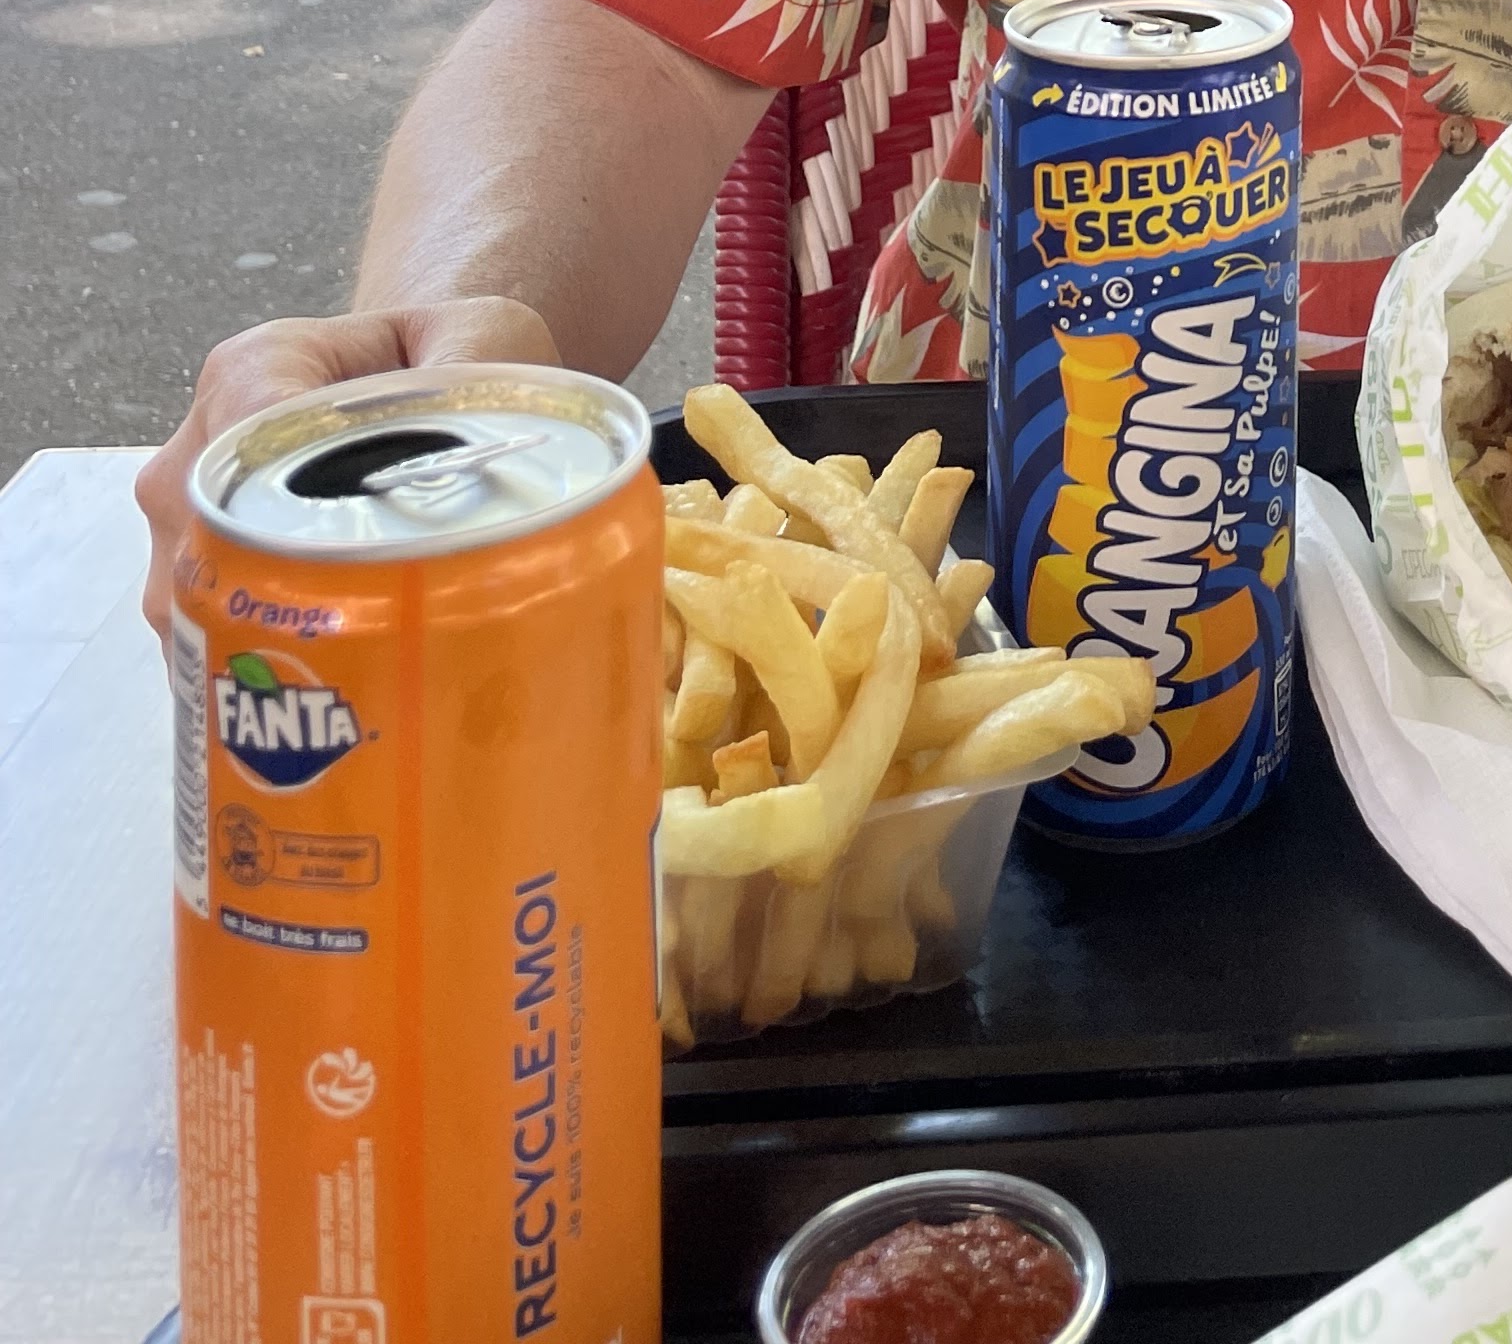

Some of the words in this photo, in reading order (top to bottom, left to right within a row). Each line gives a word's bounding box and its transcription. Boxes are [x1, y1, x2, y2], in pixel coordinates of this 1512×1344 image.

[1066, 85, 1180, 118] ÉDITION
[1188, 74, 1274, 115] LIMITÉE
[1041, 163, 1089, 210] LE
[1099, 158, 1186, 205] JEU
[1195, 145, 1223, 186] À
[1072, 293, 1258, 791] OANGINA
[227, 586, 344, 639] Orange
[214, 676, 360, 752] FANTA
[512, 868, 558, 1339] RECYCLE-MOI
[563, 1069, 584, 1141] 100%
